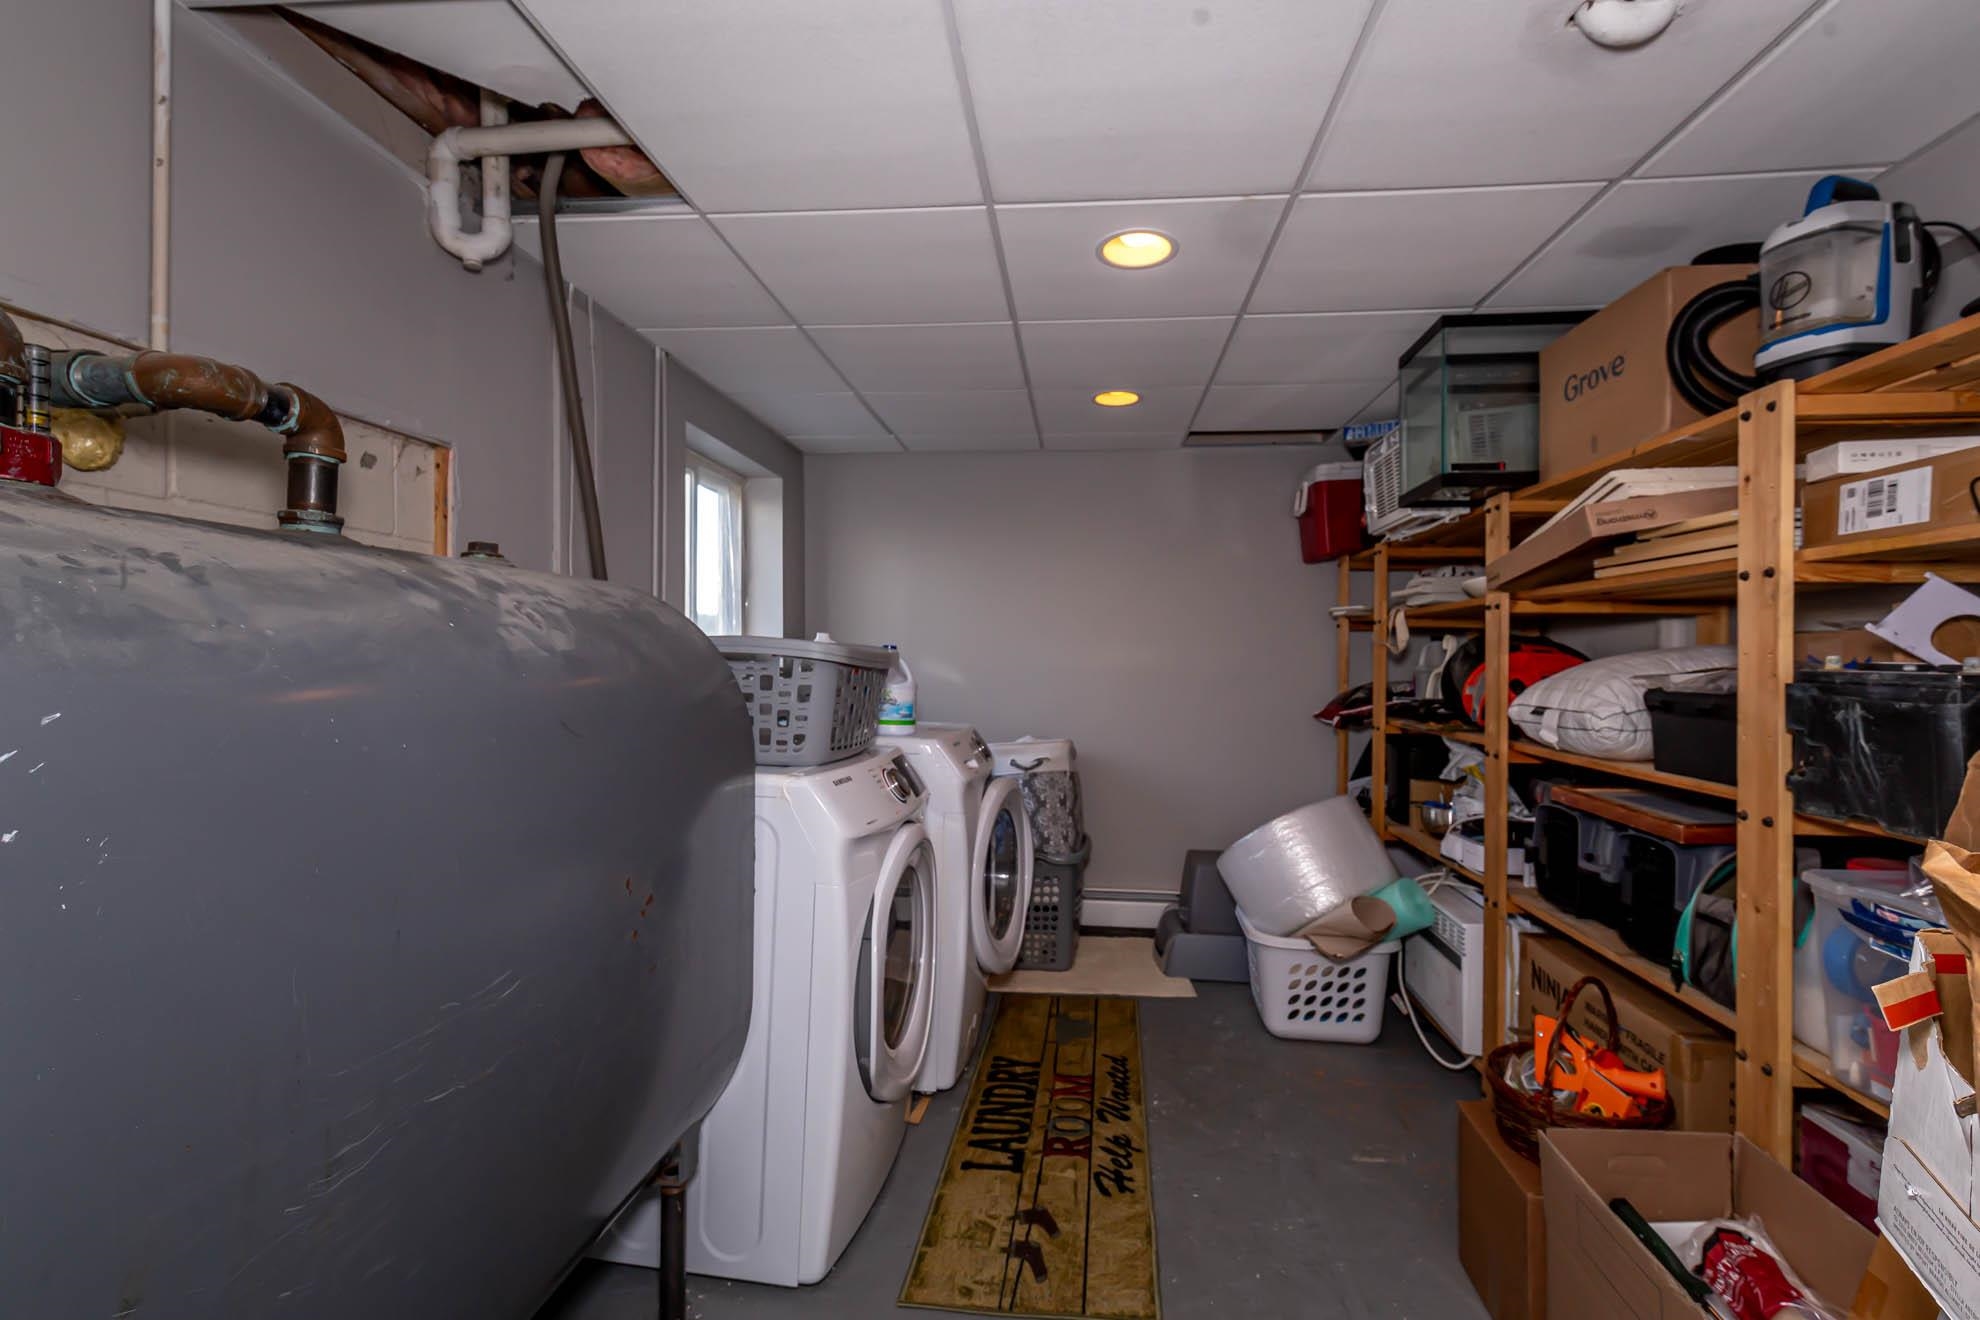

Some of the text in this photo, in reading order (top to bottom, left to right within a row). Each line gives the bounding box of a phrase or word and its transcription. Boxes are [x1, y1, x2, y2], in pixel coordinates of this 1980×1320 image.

[1564, 354, 1626, 402] Grove
[960, 1056, 1041, 1174] LAUNDRY
[1043, 1073, 1093, 1159] ROOM
[1093, 1053, 1144, 1198] Help Wanted
